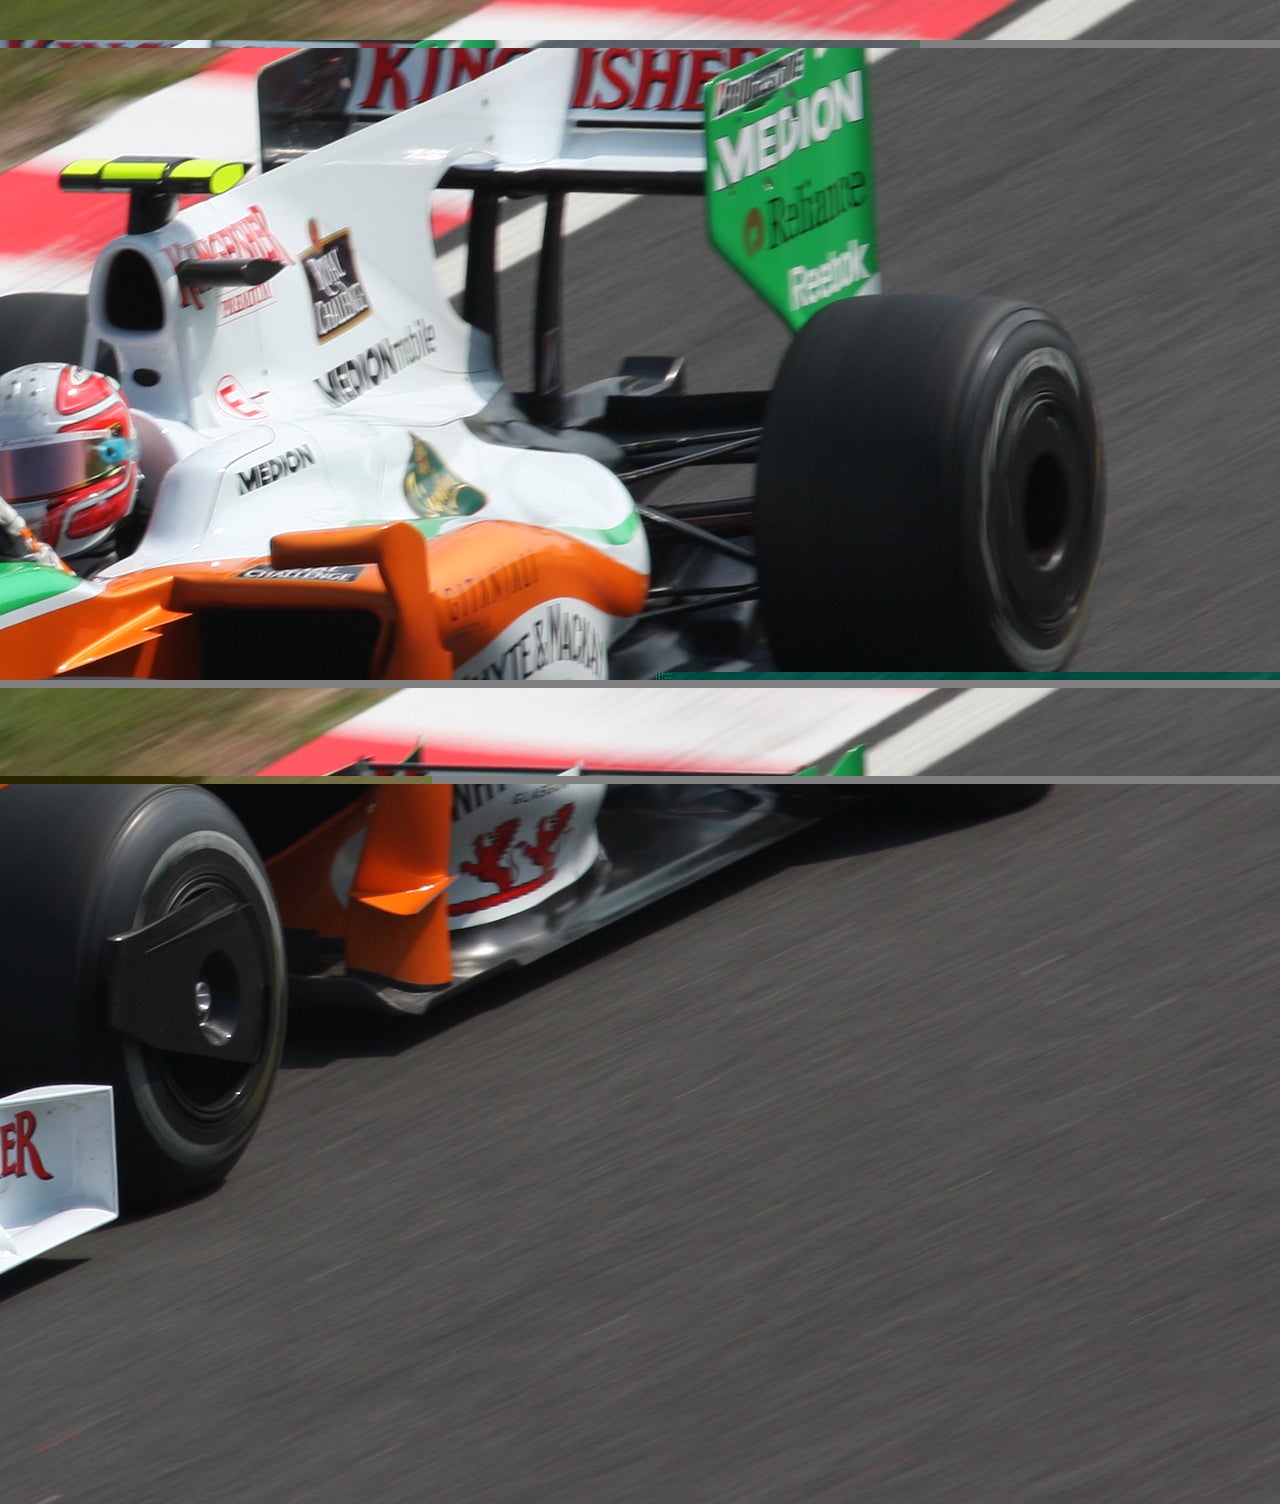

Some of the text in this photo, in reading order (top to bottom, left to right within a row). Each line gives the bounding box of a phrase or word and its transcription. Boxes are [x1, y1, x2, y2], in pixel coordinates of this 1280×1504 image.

[713, 69, 864, 192] MEDION
[767, 171, 870, 250] Reliance
[787, 239, 871, 312] Reebok
[235, 443, 317, 497] MEDION
